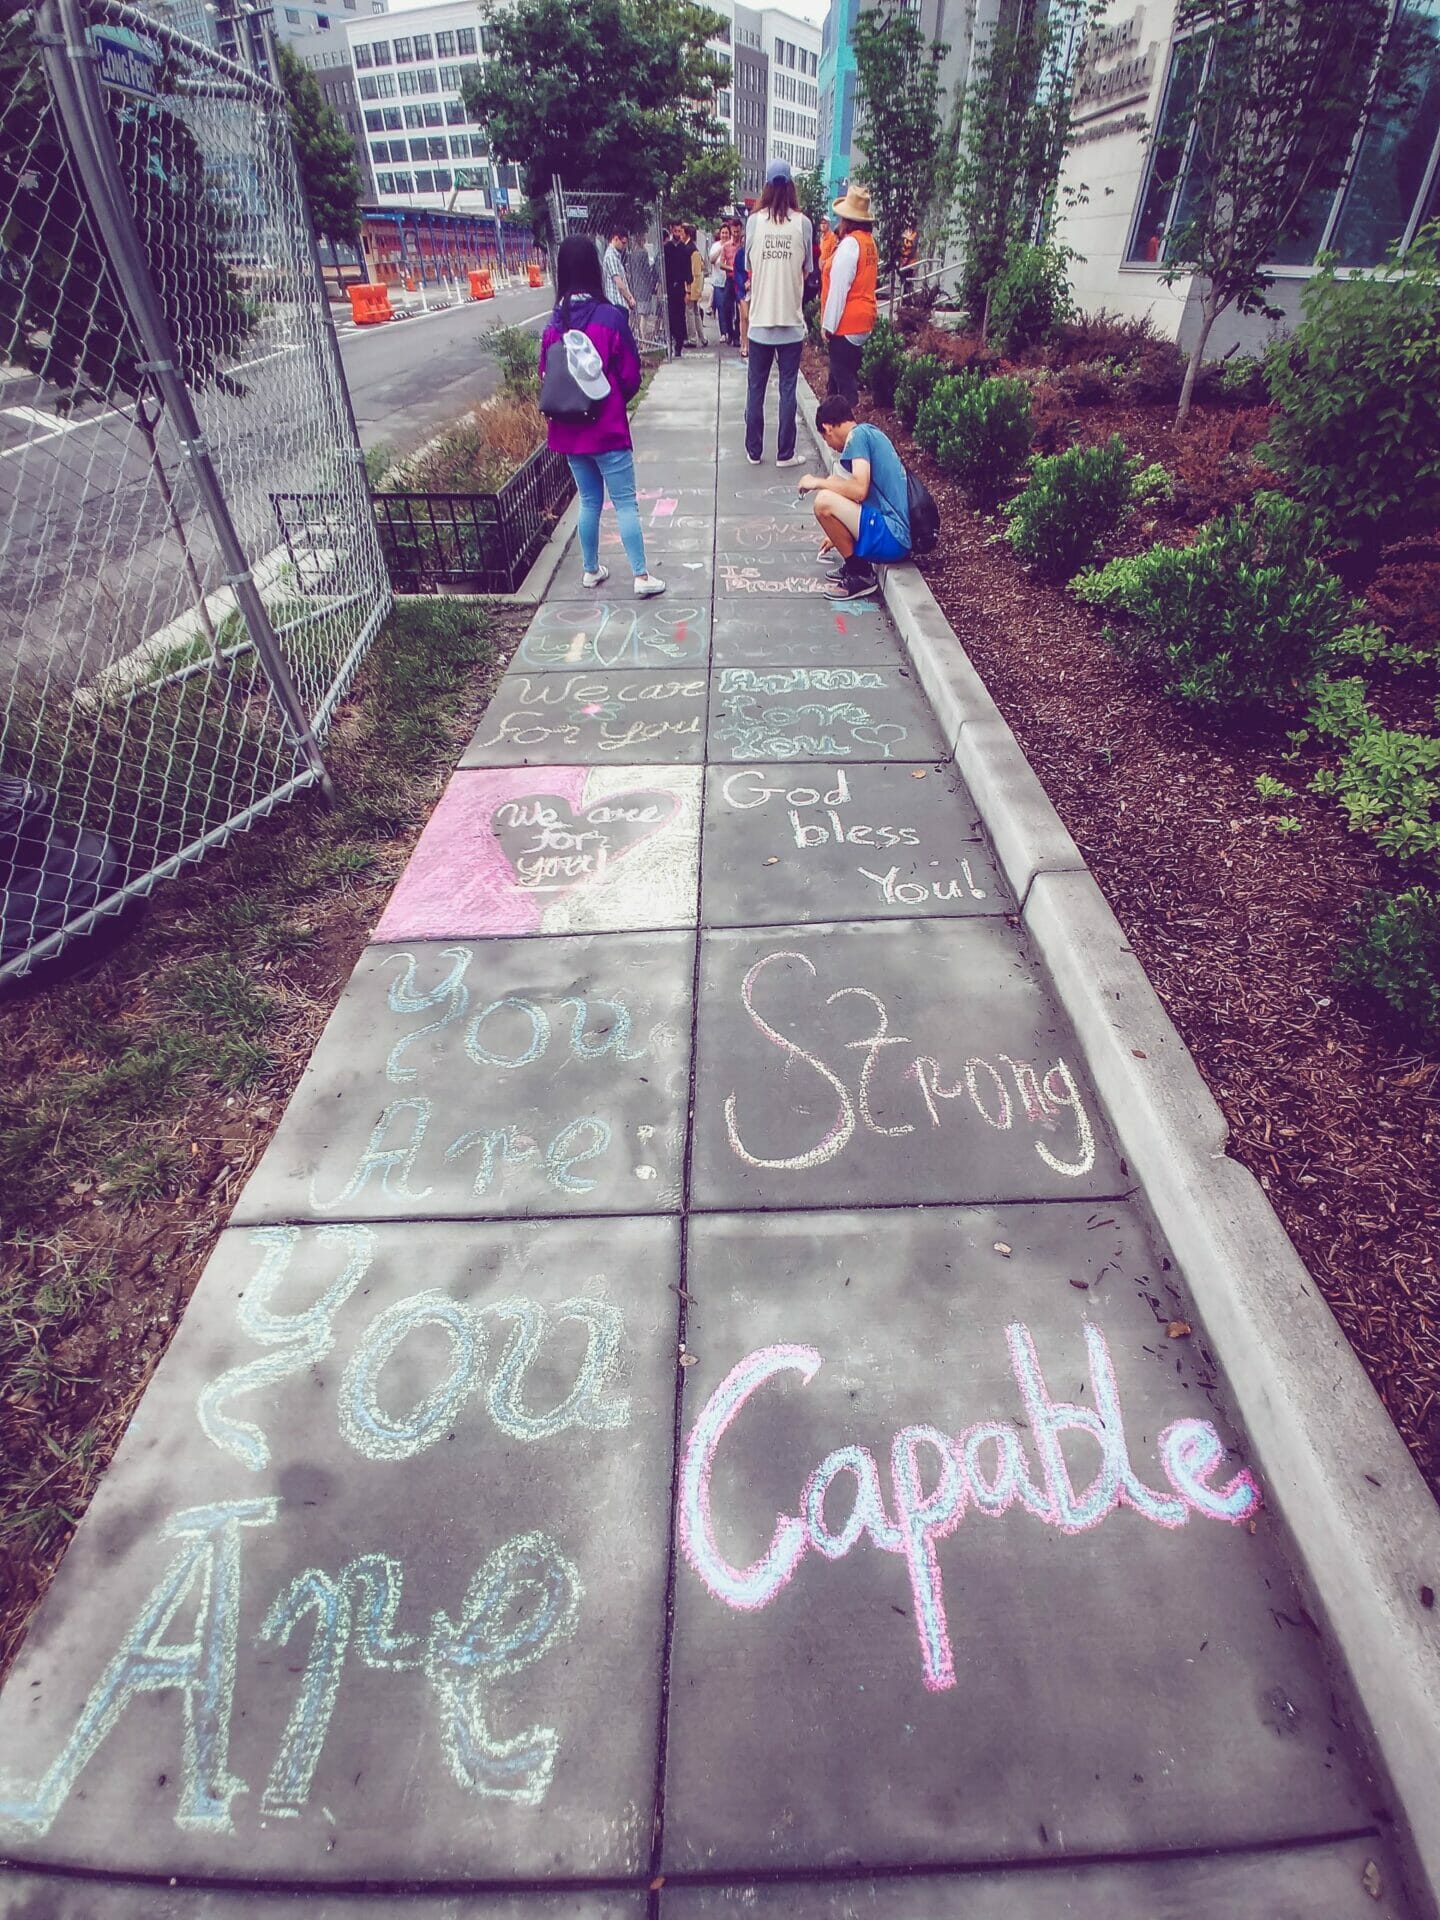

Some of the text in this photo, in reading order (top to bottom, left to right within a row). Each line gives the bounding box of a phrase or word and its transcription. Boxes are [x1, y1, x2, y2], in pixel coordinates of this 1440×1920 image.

[762, 250, 792, 260] ESCORT
[765, 240, 791, 250] CLINIC
[518, 676, 706, 704] We care
[597, 716, 700, 751] you
[722, 769, 851, 809] God
[498, 801, 573, 829] We
[787, 809, 921, 848] bless
[857, 857, 986, 904] You!
[724, 951, 1096, 1178] Strong
[680, 1320, 1263, 1694] Capable
[0, 1497, 587, 1838] Are
